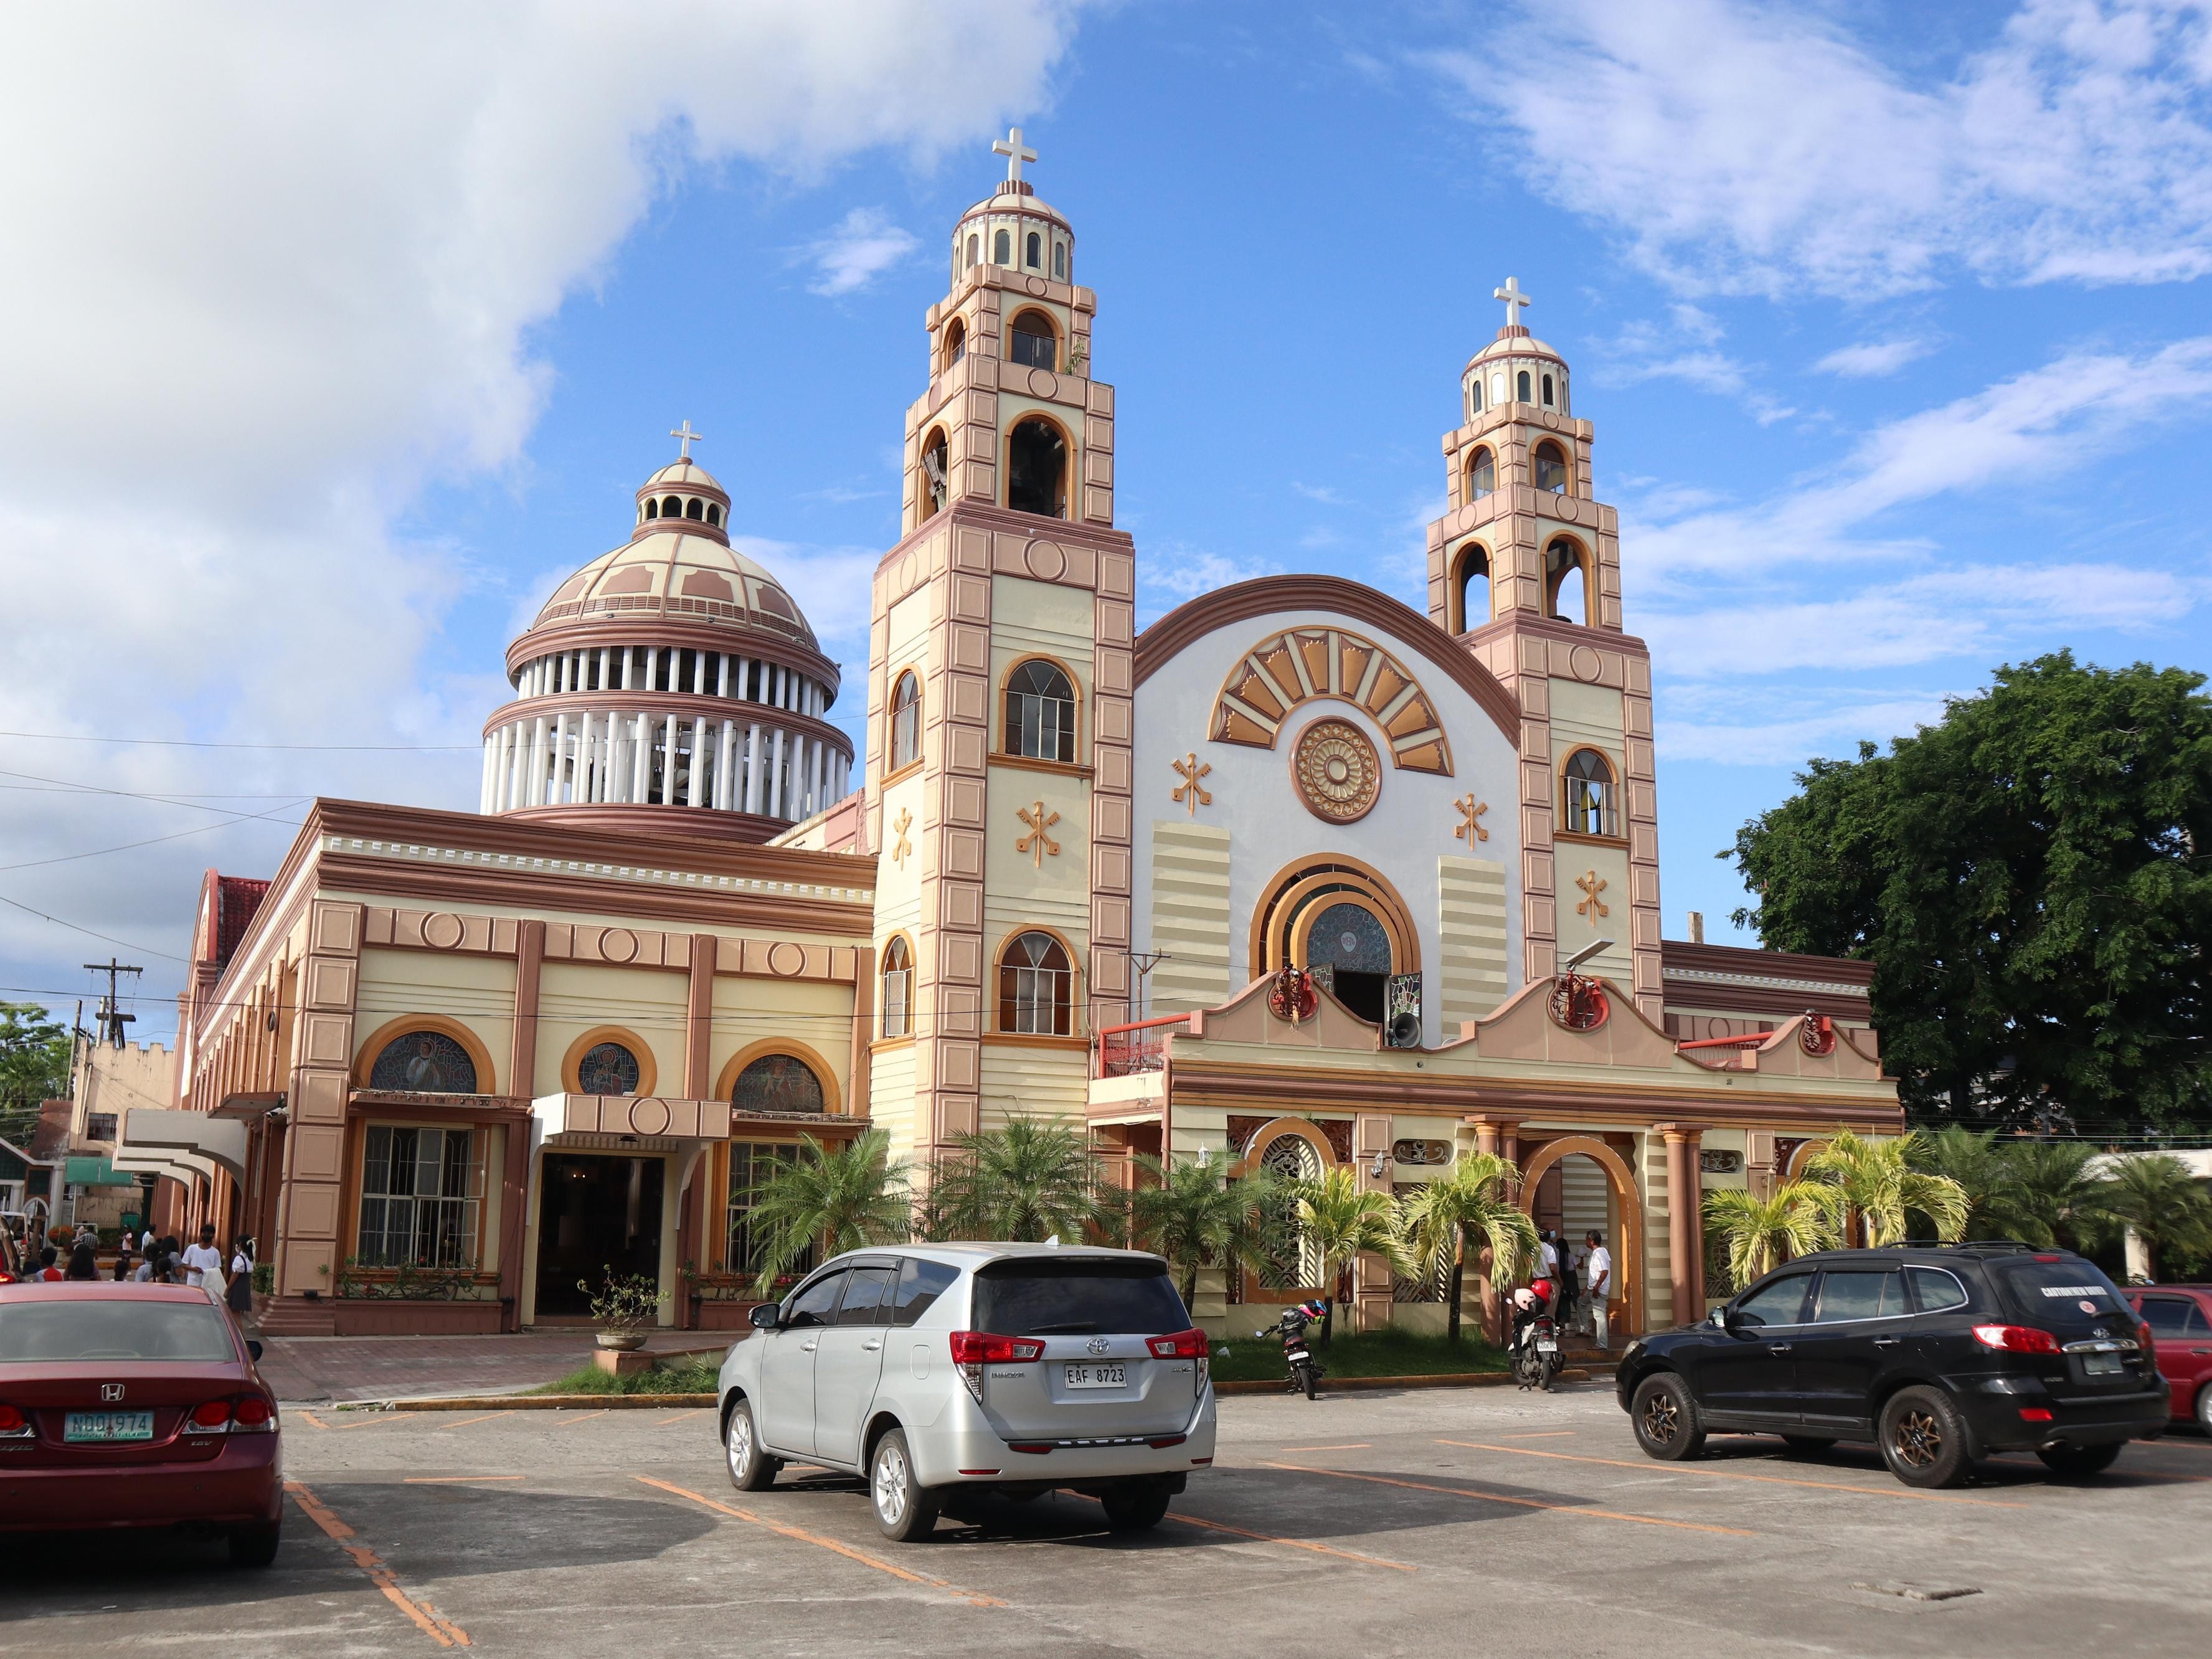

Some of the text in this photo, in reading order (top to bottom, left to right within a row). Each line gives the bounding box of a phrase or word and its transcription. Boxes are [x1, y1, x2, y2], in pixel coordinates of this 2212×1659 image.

[1067, 1369, 1124, 1383] EAF 8723
[116, 1414, 146, 1431] 974
